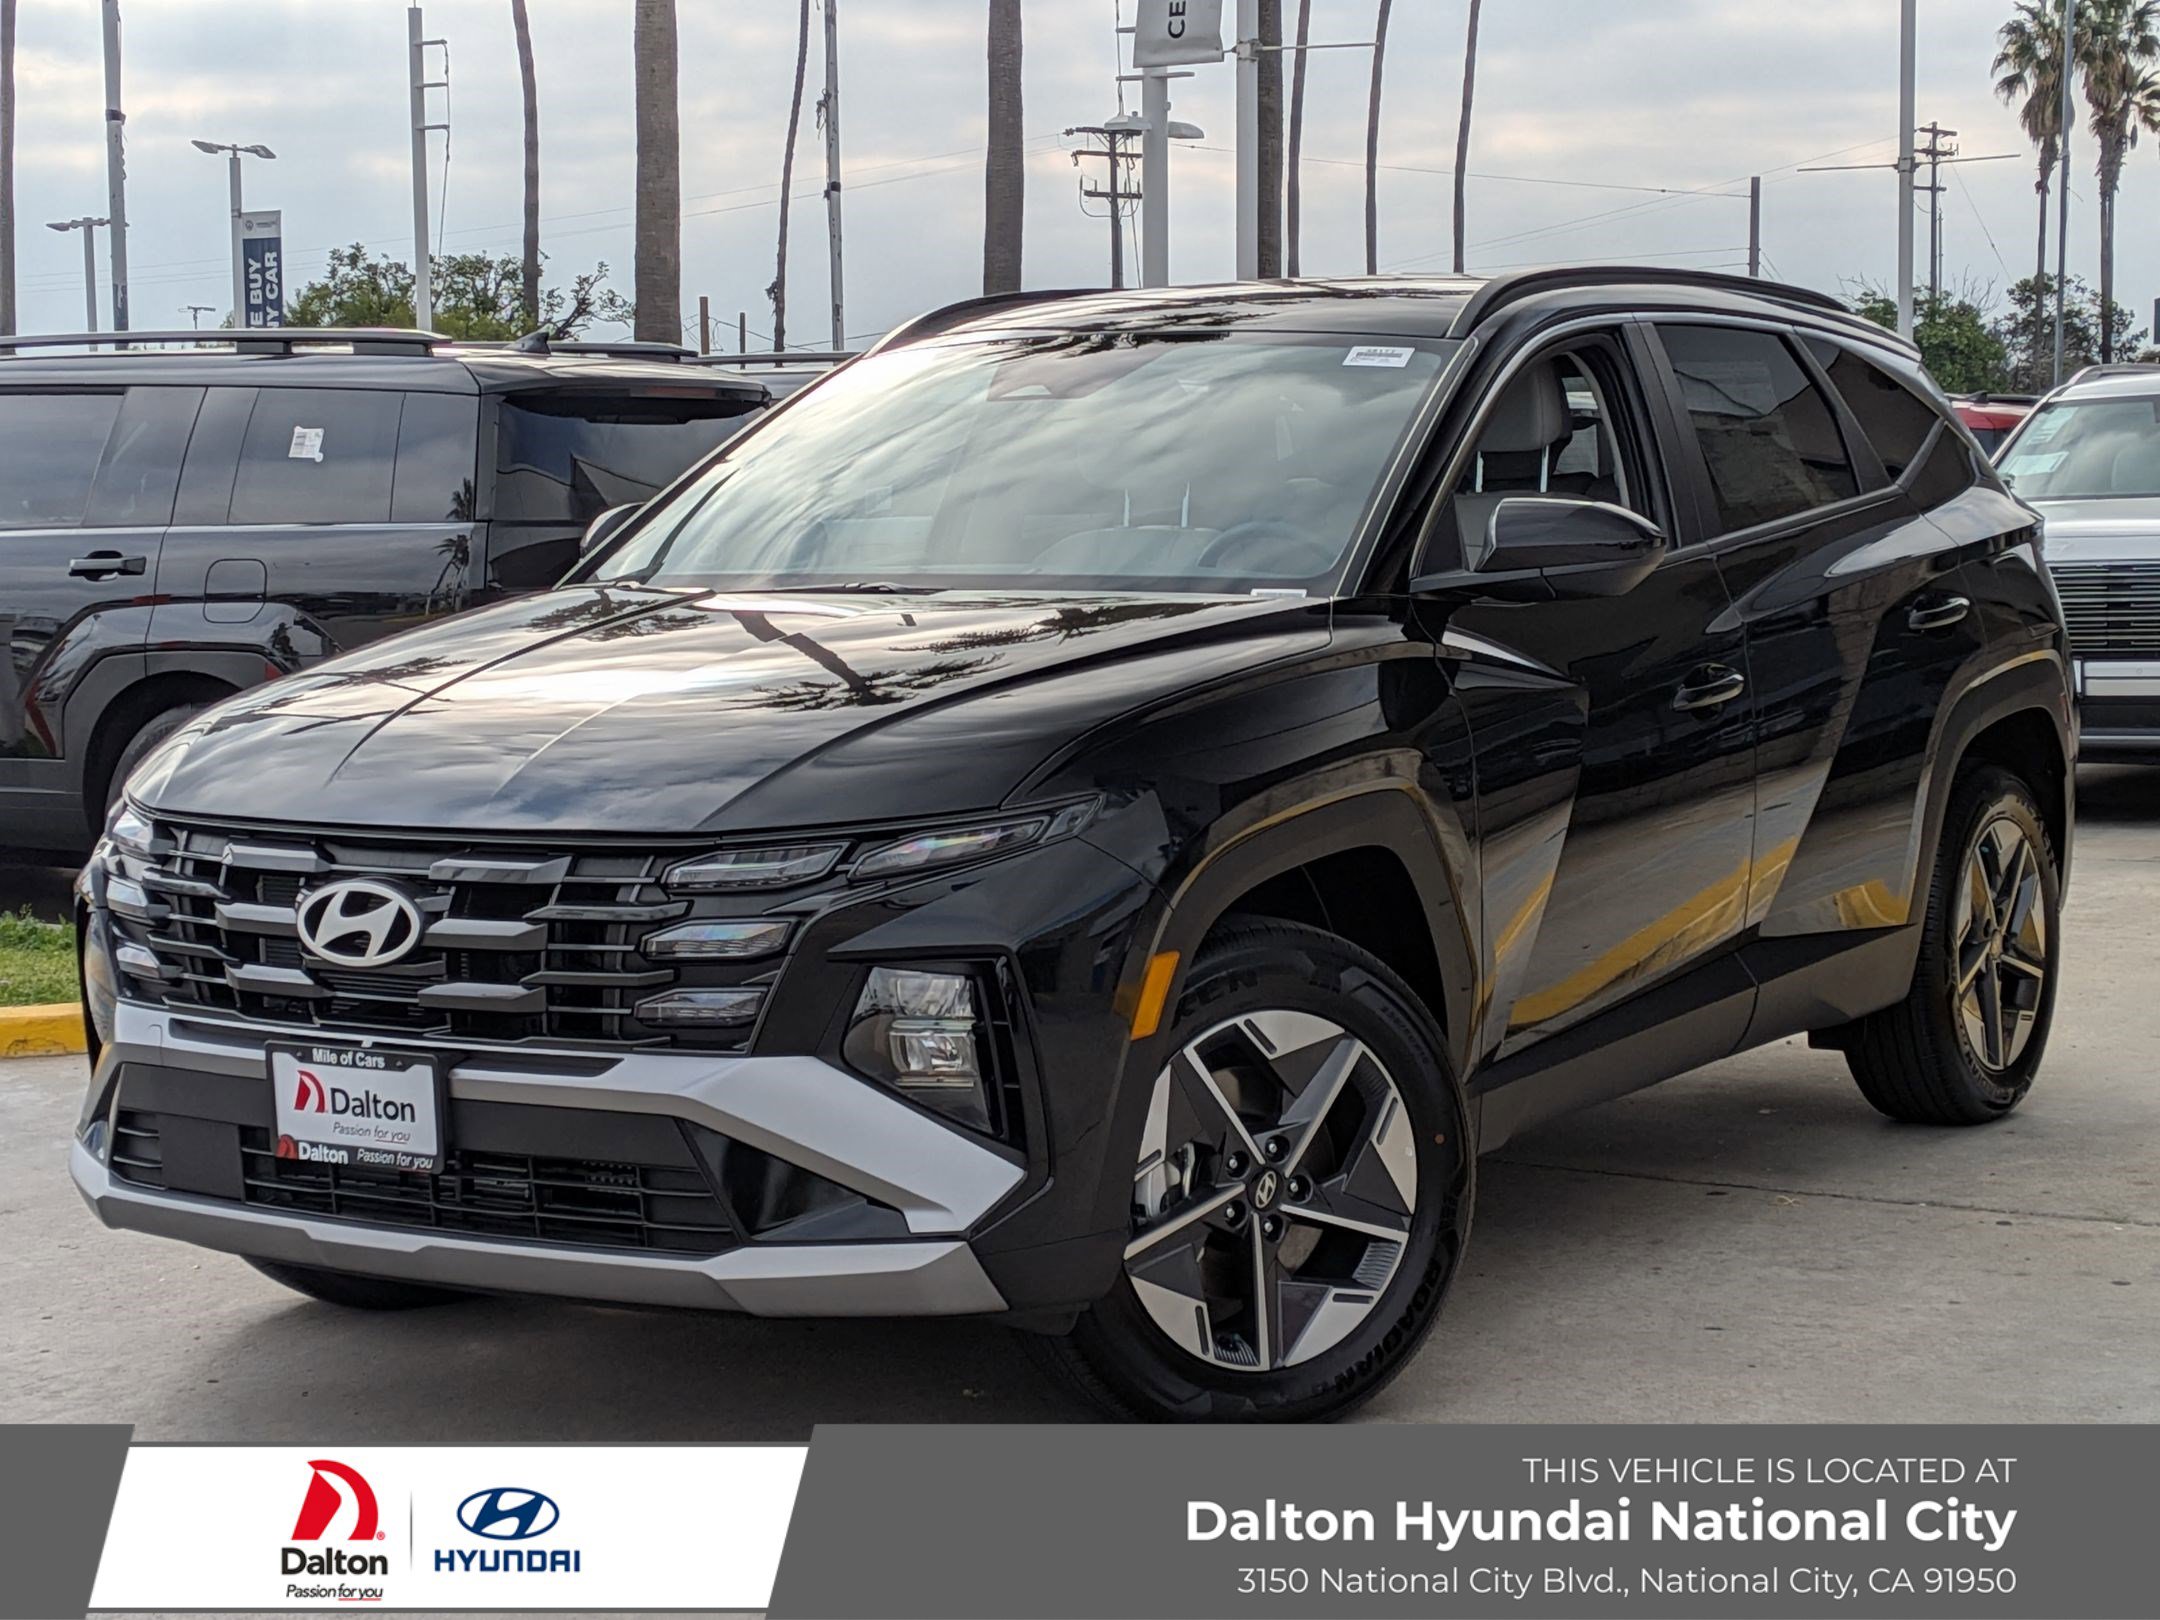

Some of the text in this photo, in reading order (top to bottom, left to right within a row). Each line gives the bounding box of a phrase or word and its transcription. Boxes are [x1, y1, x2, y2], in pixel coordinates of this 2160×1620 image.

[264, 251, 279, 300] CAR
[248, 258, 264, 328] E BUY
[312, 1048, 386, 1068] Mile of Cars
[330, 1087, 416, 1123] Dalton
[333, 1122, 411, 1142] Passion for you
[298, 1142, 434, 1170] Dalton Passion for you
